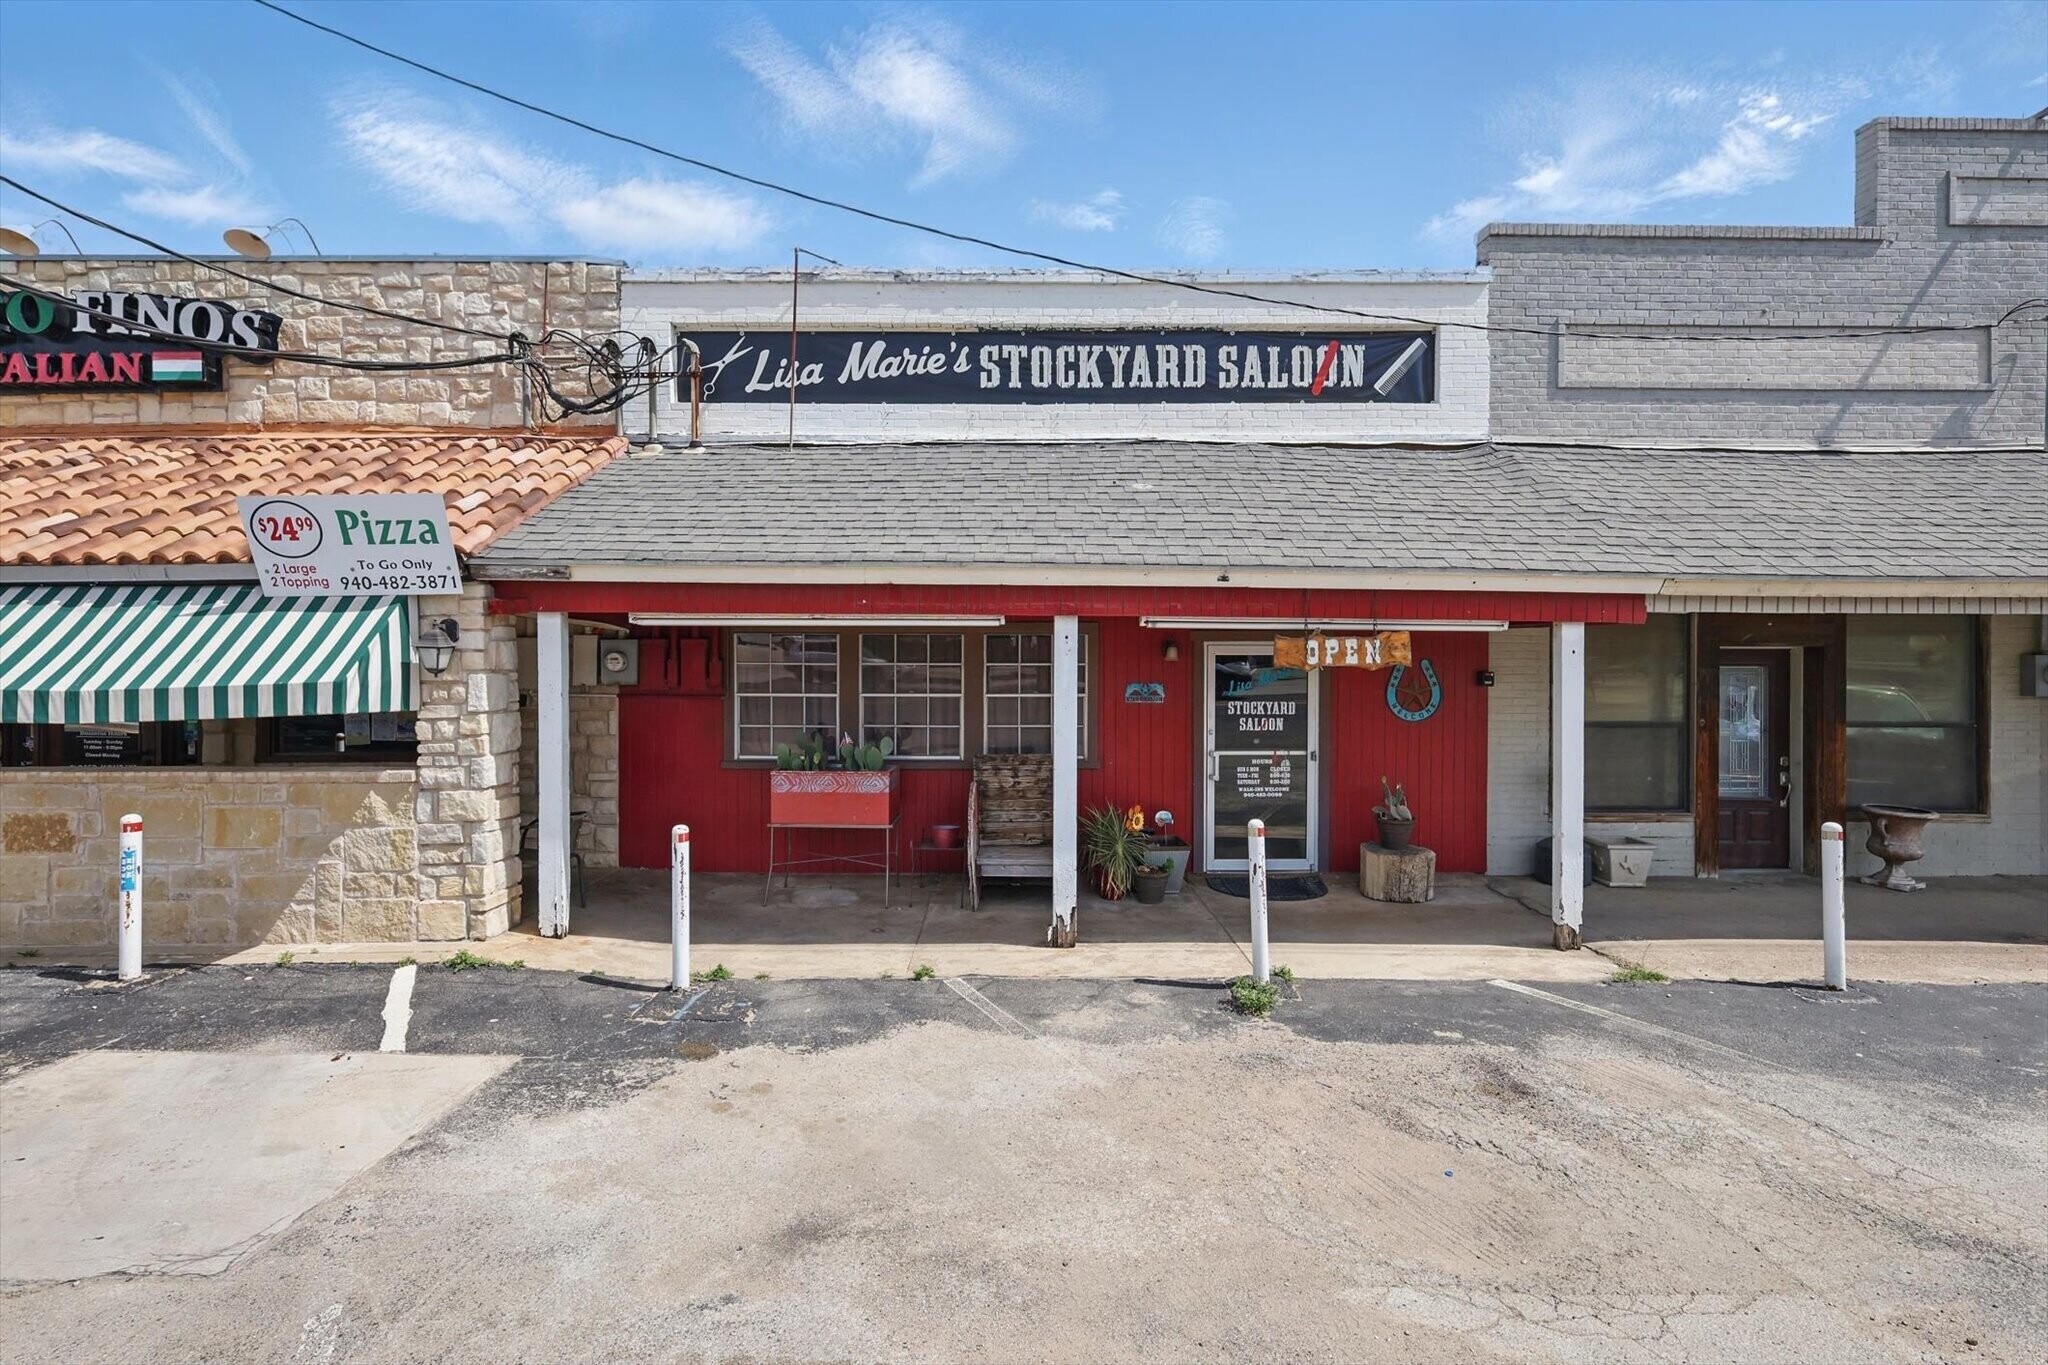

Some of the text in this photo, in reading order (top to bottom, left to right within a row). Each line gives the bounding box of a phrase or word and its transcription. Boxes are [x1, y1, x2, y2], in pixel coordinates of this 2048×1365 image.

[72, 291, 262, 349] FINOS
[0, 351, 142, 383] ALIAN
[744, 340, 1366, 393] Lisa Marie's STOCKYARD SALOON
[334, 510, 440, 545] Pizza
[272, 563, 317, 576] 2 Large
[357, 559, 433, 571] To Go Only
[271, 576, 330, 590] 2 Topping
[340, 575, 457, 590] 940-482-3871
[1306, 638, 1382, 665] OPEN
[1227, 701, 1296, 715] STOCKYARD
[1391, 702, 1437, 719] WELCOME
[1239, 717, 1284, 731] SALOON
